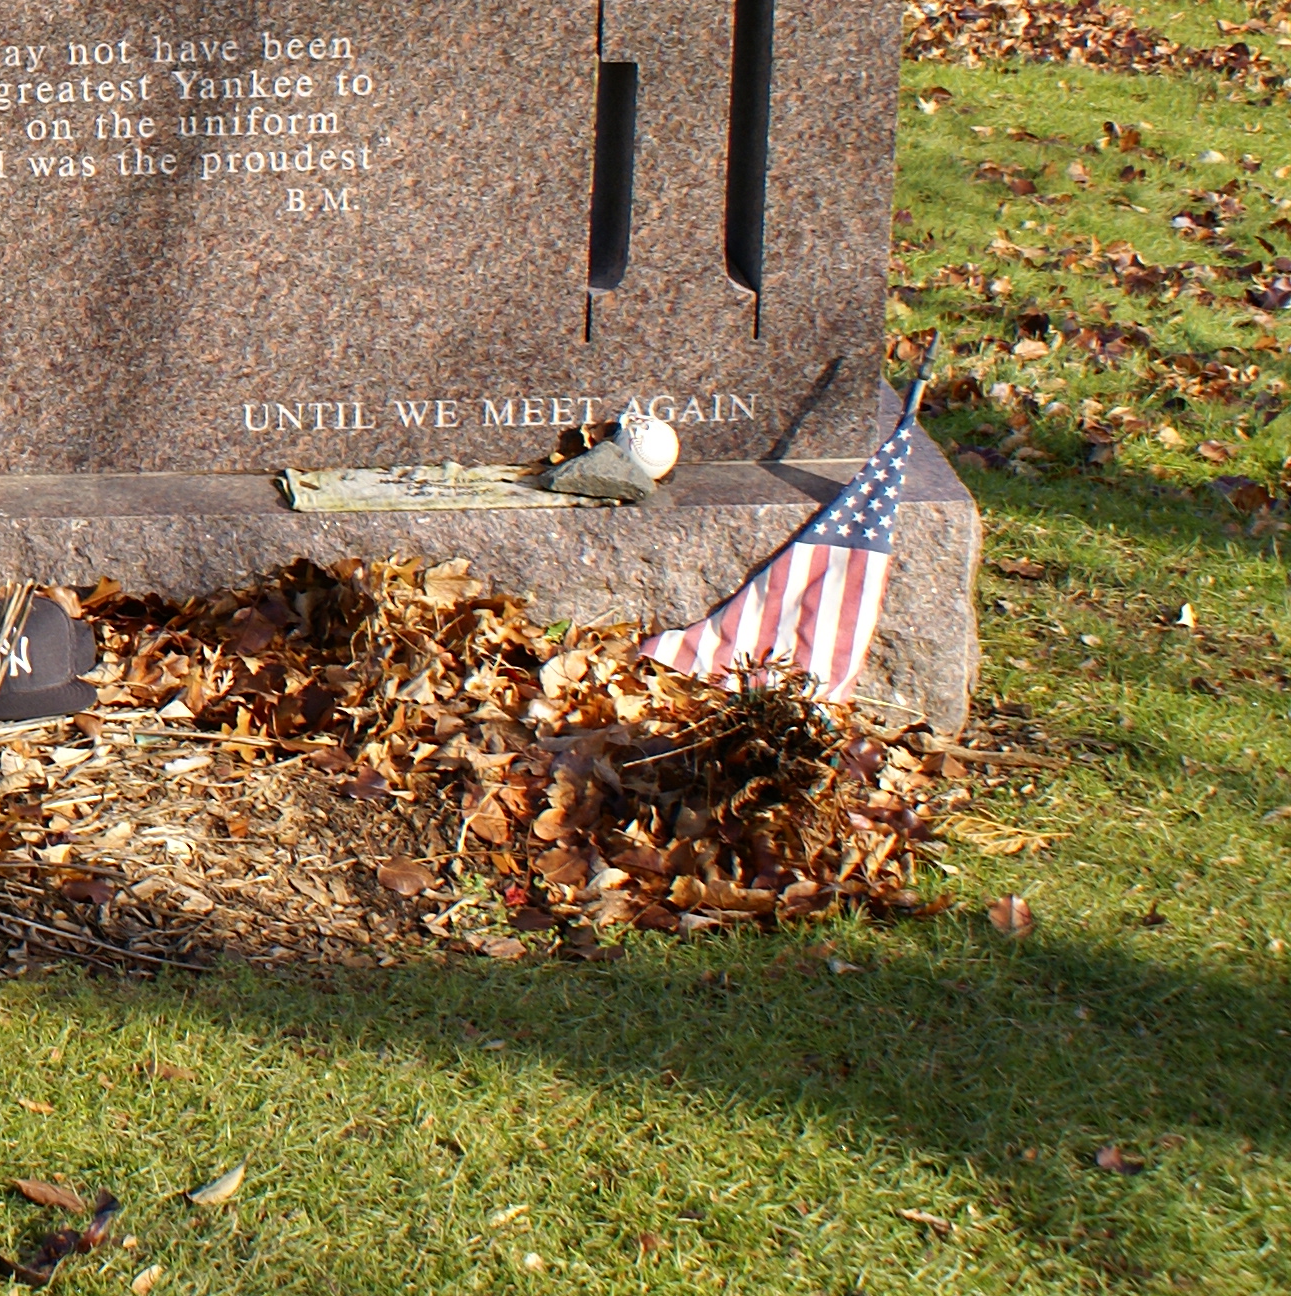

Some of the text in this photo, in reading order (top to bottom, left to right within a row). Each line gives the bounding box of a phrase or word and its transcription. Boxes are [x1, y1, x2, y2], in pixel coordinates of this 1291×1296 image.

[69, 39, 131, 65] not
[153, 35, 240, 64] have
[261, 31, 354, 61] been
[173, 69, 314, 101] Yankee
[336, 68, 374, 96] to
[26, 116, 71, 142] on
[96, 112, 155, 139] the
[178, 106, 341, 136] uniform
[29, 153, 97, 177] was
[118, 145, 178, 175] the
[242, 393, 757, 432] UNTIL WE MEET AGAIN
